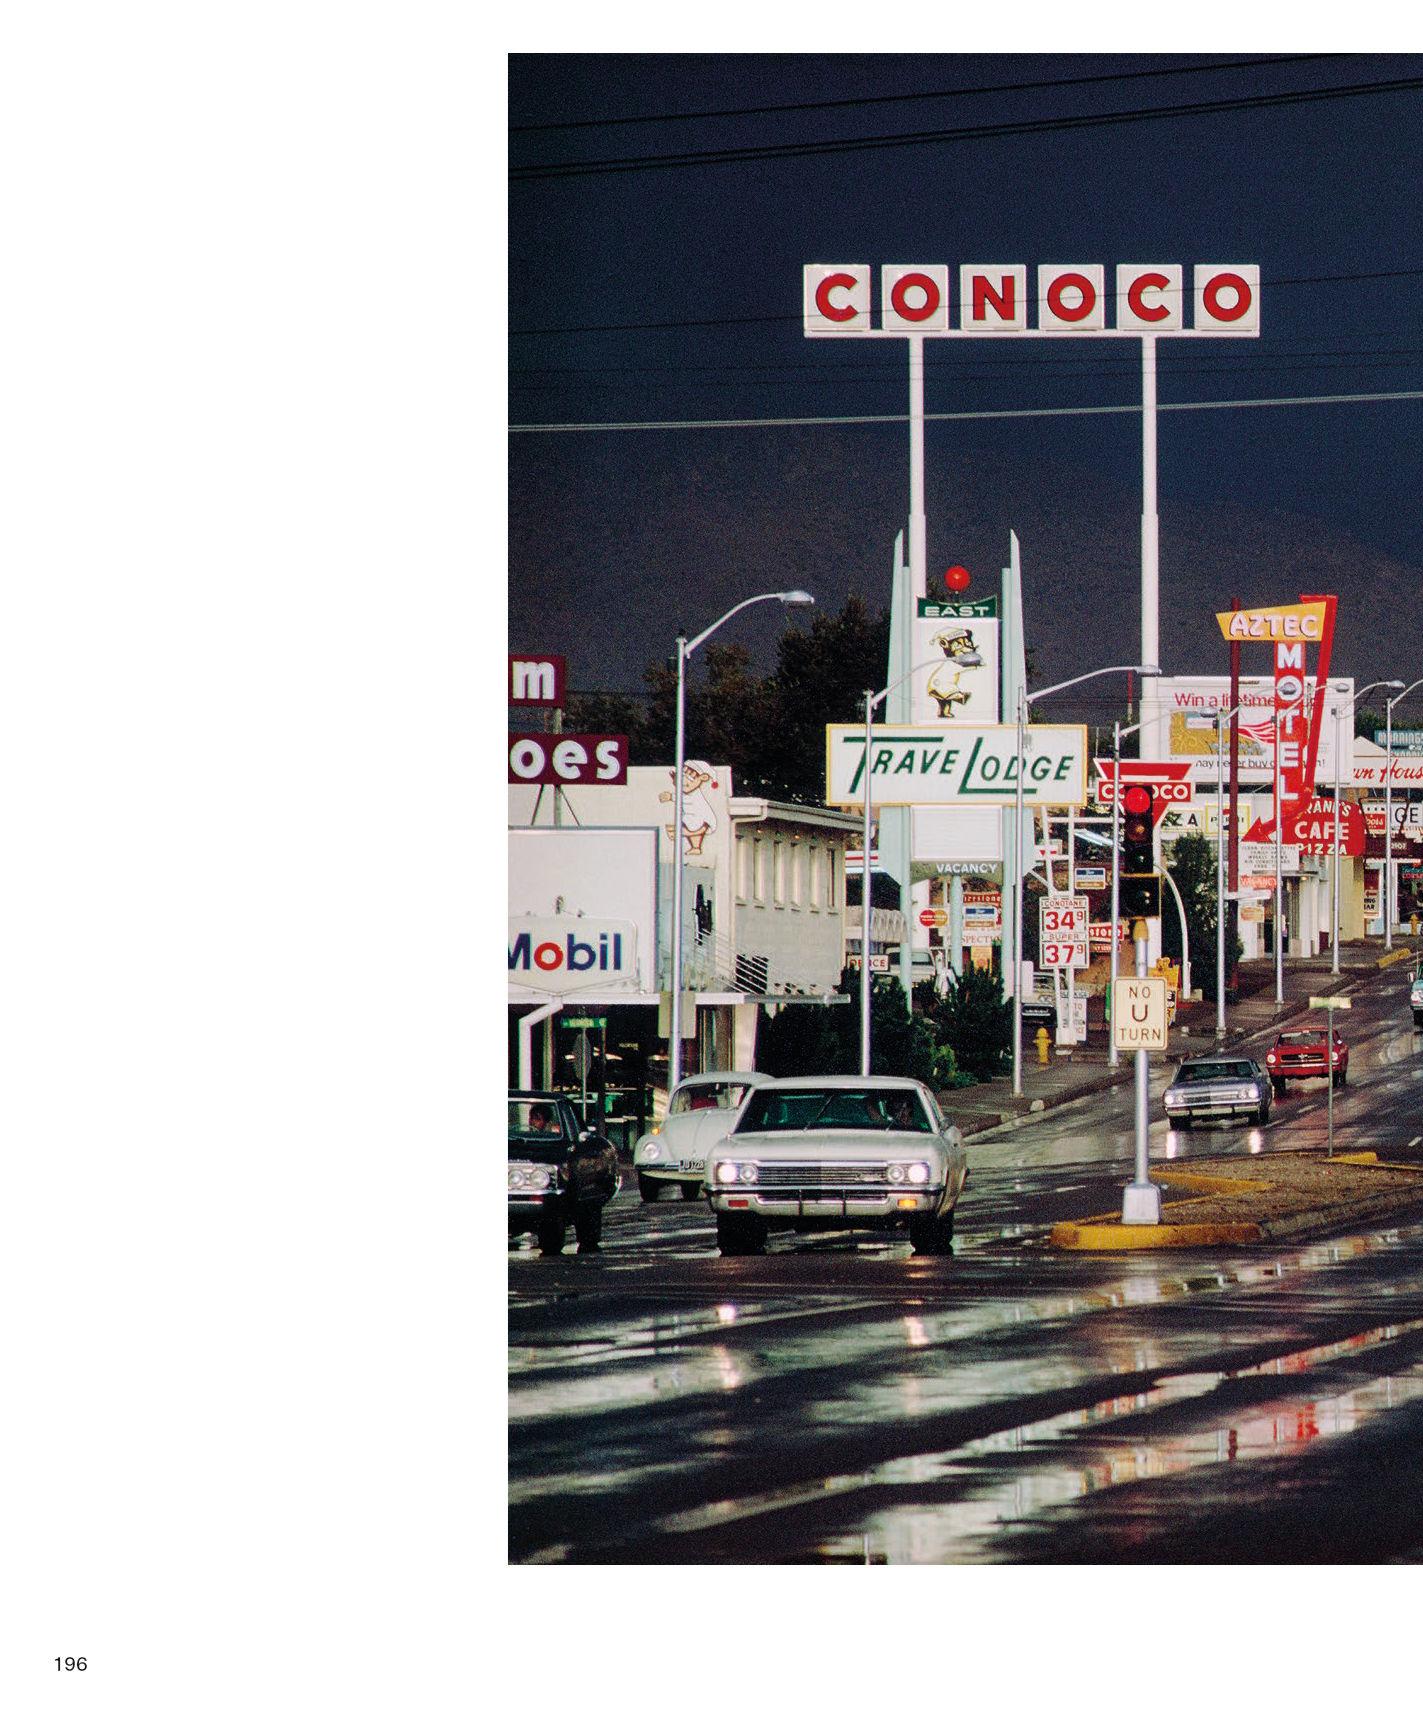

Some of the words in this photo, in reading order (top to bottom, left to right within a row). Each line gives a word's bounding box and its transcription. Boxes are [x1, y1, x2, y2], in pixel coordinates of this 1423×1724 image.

[815, 272, 1252, 322] CONOCO
[925, 605, 989, 617] EAST
[1230, 613, 1318, 637] AZTEC
[1174, 693, 1205, 707] Win
[1208, 696, 1218, 707] a
[1223, 692, 1275, 707] lietime
[1277, 643, 1302, 801] MOTEL
[509, 739, 621, 780] oes
[1101, 782, 1190, 800] CCO
[1294, 821, 1350, 841] CAFE
[1298, 843, 1347, 856] PIZZA
[935, 863, 998, 874] VACANCY
[1129, 986, 1151, 999] NO
[1131, 1004, 1149, 1022] U
[1119, 1028, 1161, 1041] TURN
